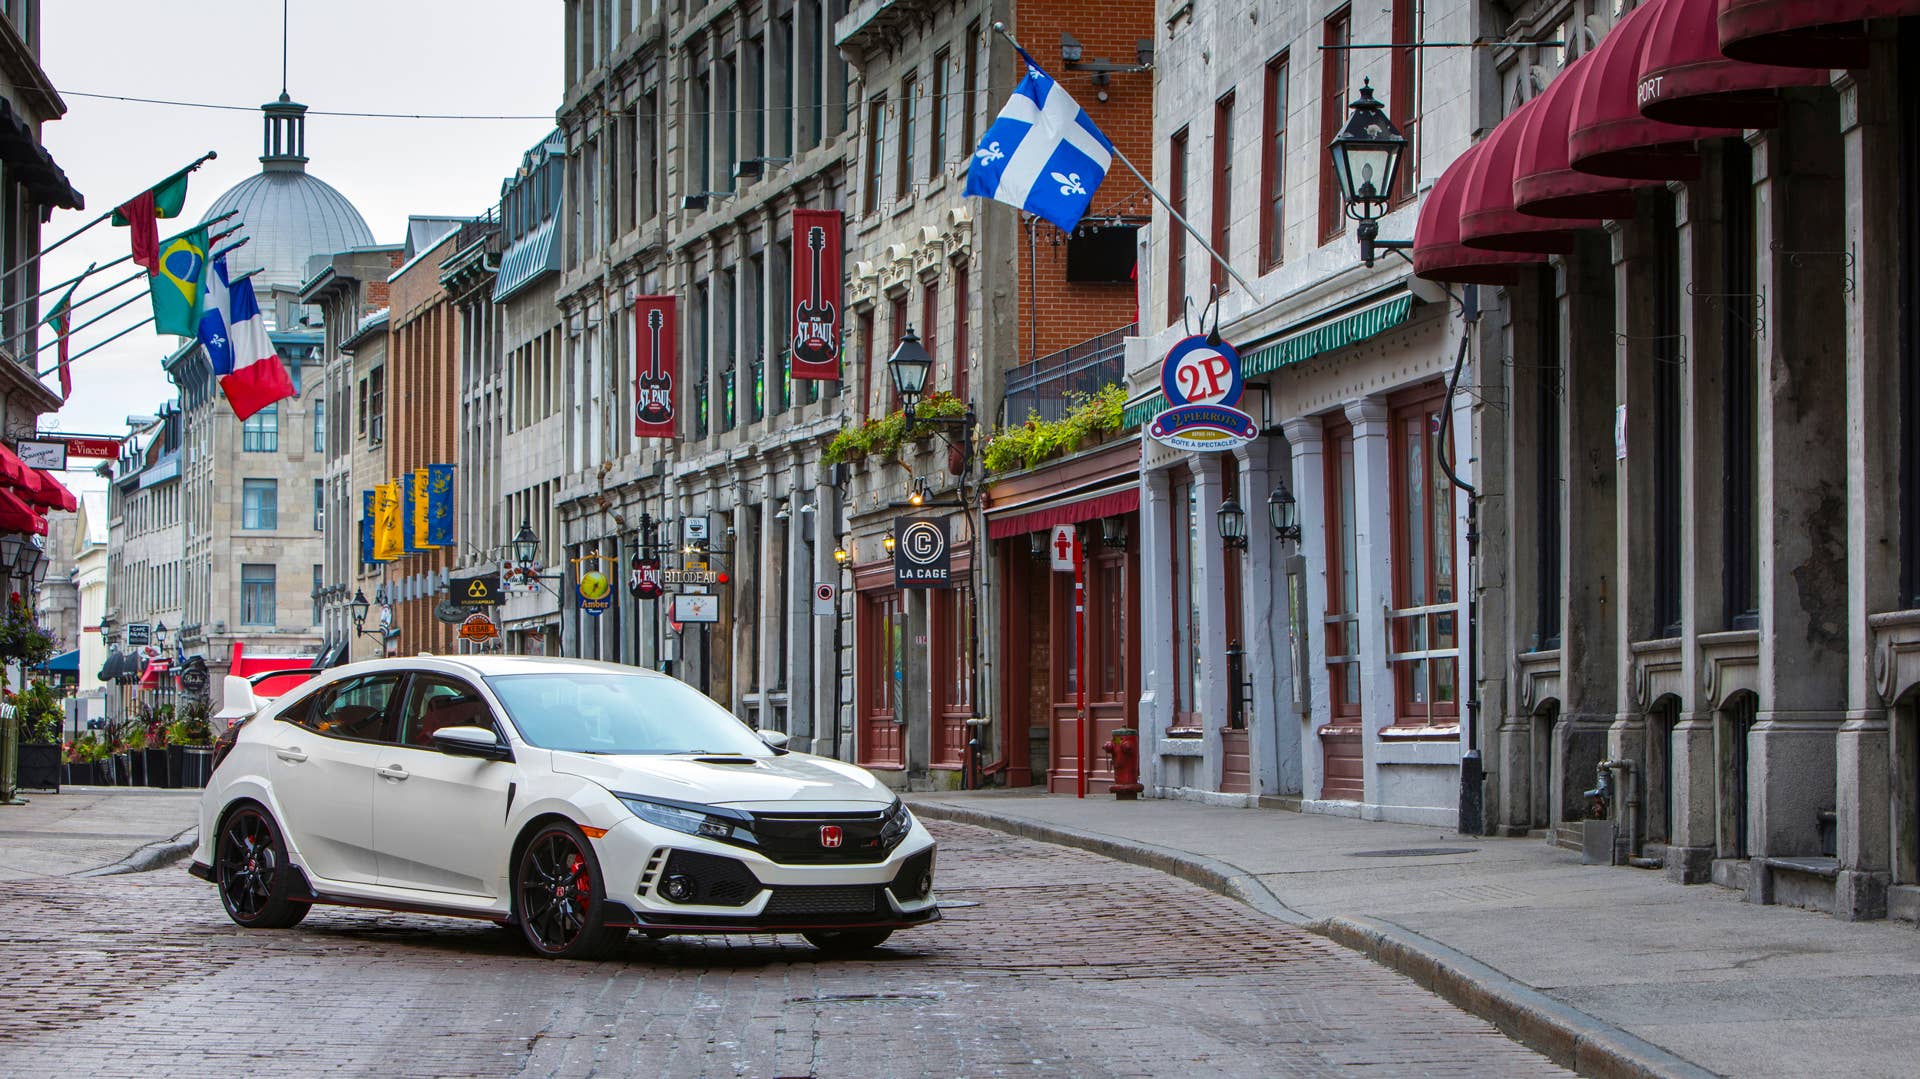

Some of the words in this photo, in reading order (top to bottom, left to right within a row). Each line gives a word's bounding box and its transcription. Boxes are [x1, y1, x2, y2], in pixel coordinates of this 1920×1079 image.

[797, 322, 810, 350] ST.
[811, 322, 835, 351] PAUL
[1177, 355, 1232, 403] 2P
[640, 389, 650, 411] ST.
[651, 389, 671, 412] PAUL
[1172, 413, 1183, 428] 2
[1183, 411, 1238, 427] PIERROTS
[67, 444, 109, 456] t-Vincent
[1197, 439, 1238, 449] SPECTACLES
[630, 569, 643, 589] ST.
[644, 569, 662, 589] PAUL
[664, 571, 716, 583] BILODEAU
[899, 569, 913, 579] LA
[916, 569, 947, 579] CAGE
[582, 599, 609, 609] Amber
[467, 625, 489, 634] KEBAB
